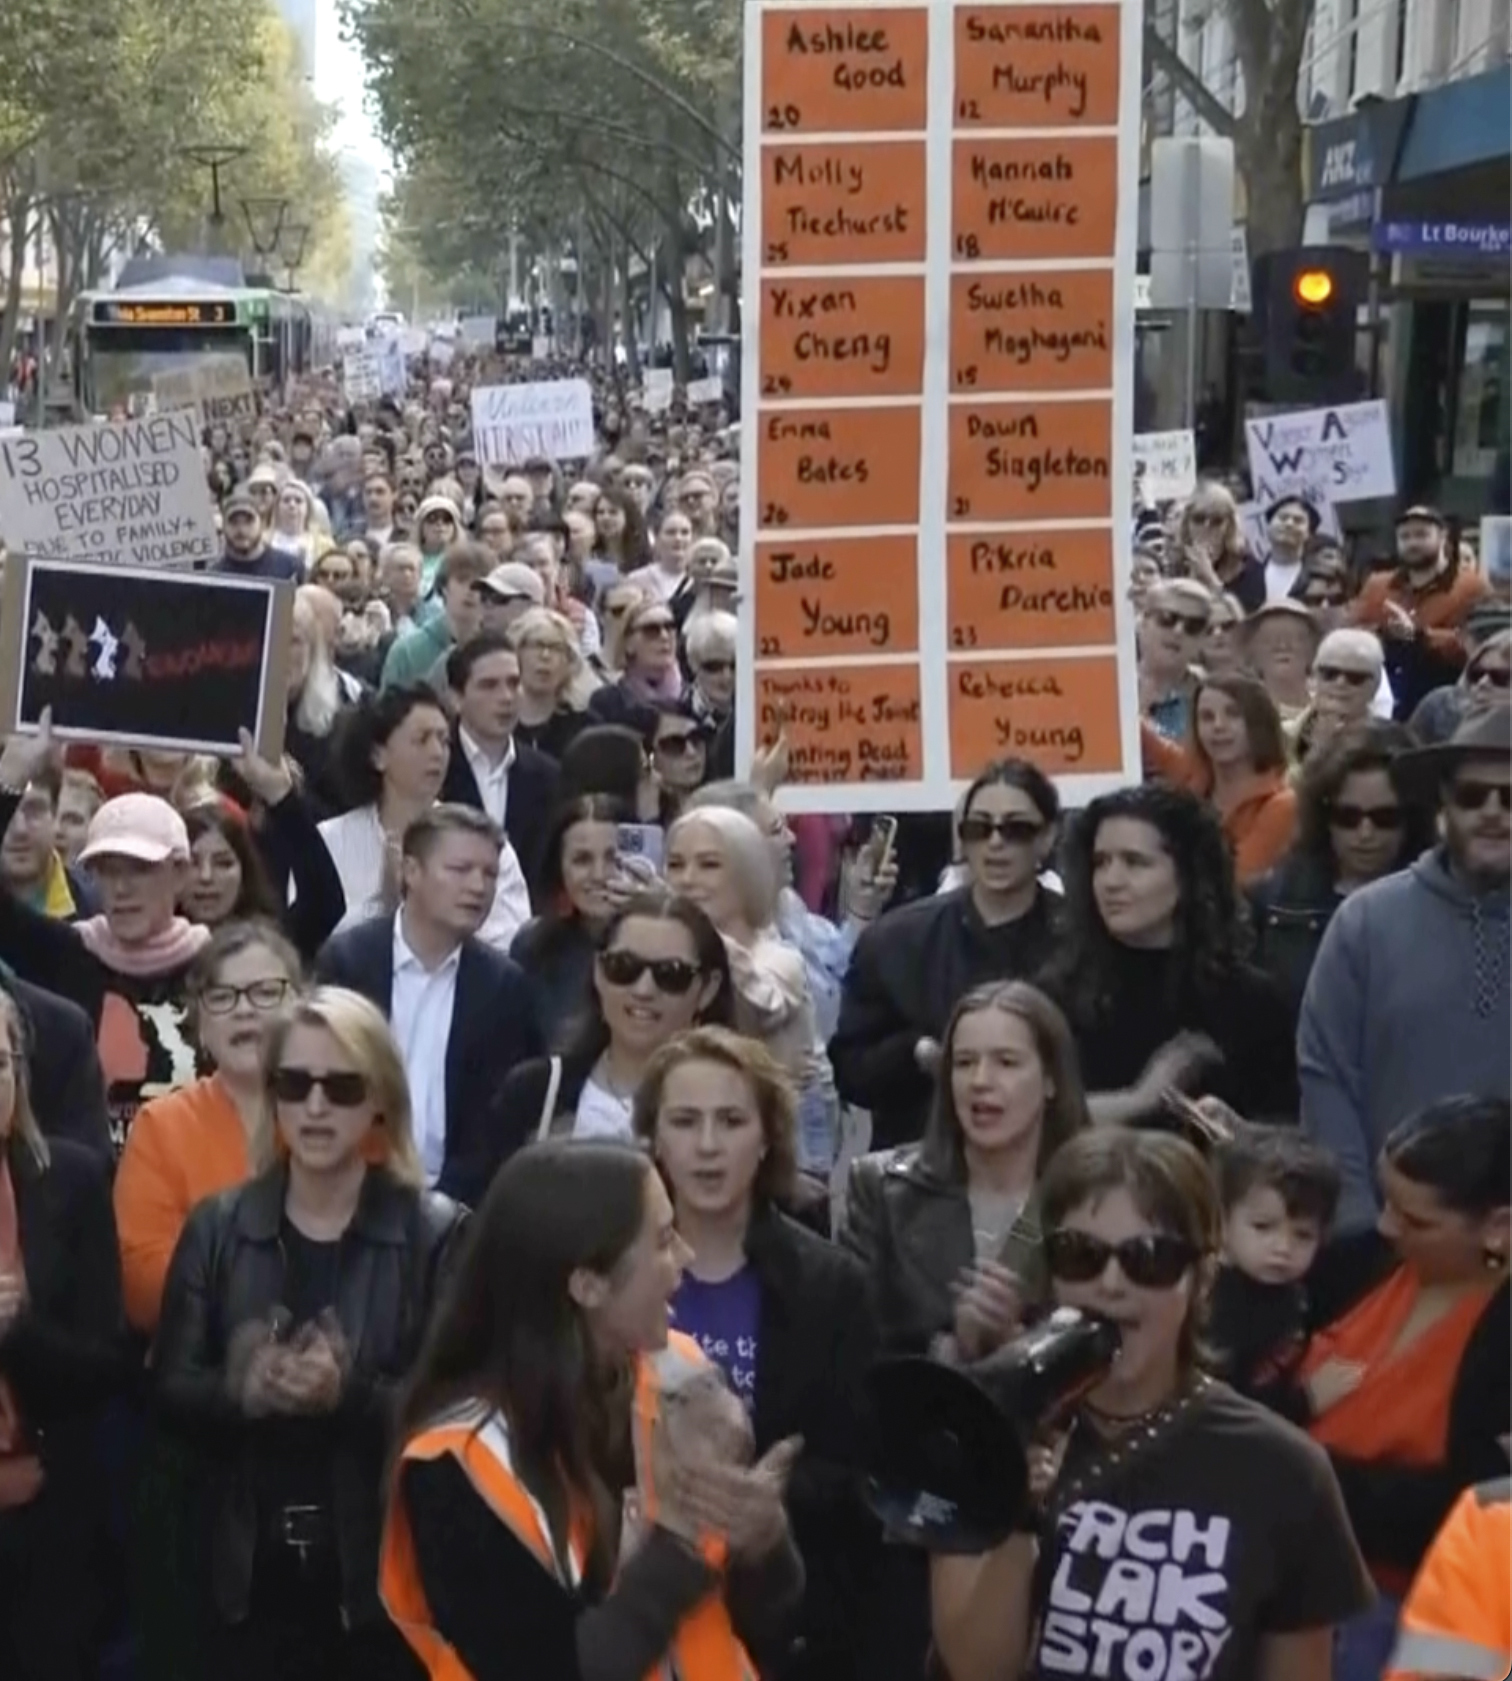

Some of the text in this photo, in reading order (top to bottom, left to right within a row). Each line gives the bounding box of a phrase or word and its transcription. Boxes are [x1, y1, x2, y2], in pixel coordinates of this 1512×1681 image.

[787, 21, 889, 53] Ashlee
[965, 15, 1102, 43] Samantha
[833, 59, 905, 90] Good
[991, 61, 1086, 117] Murphy
[767, 104, 800, 129] 20
[959, 99, 981, 119] 12
[774, 155, 862, 193] Molly
[971, 155, 1073, 189] Hannah
[1321, 141, 1356, 188] ANZ
[956, 233, 980, 258] 18
[1422, 221, 1440, 242] Lt
[1443, 222, 1511, 245] Bourke
[770, 288, 857, 318] Yixan
[968, 282, 1065, 311] Swetha
[795, 330, 890, 373] Cheng
[956, 365, 978, 385] 15
[201, 394, 251, 420] NEXT
[767, 416, 831, 441] Emma
[967, 415, 1038, 439] Dawn
[2, 415, 199, 478] 13 WOMEN
[23, 460, 179, 505] HOSPITALISED
[797, 455, 870, 484] Bates
[986, 445, 1108, 492] Singleton
[54, 491, 161, 531] EVERYDAY
[77, 530, 104, 549] TO
[131, 536, 213, 564] VIOLENCE
[769, 552, 836, 584] Jade
[970, 541, 1057, 574] Pikria
[801, 597, 890, 647] Young
[952, 625, 977, 647] 23
[762, 676, 850, 696] Thanks to
[958, 671, 1064, 699] Rebecca
[839, 701, 867, 725] the
[872, 694, 920, 723] Joint
[858, 737, 909, 762] Dead
[995, 716, 1085, 762] Young
